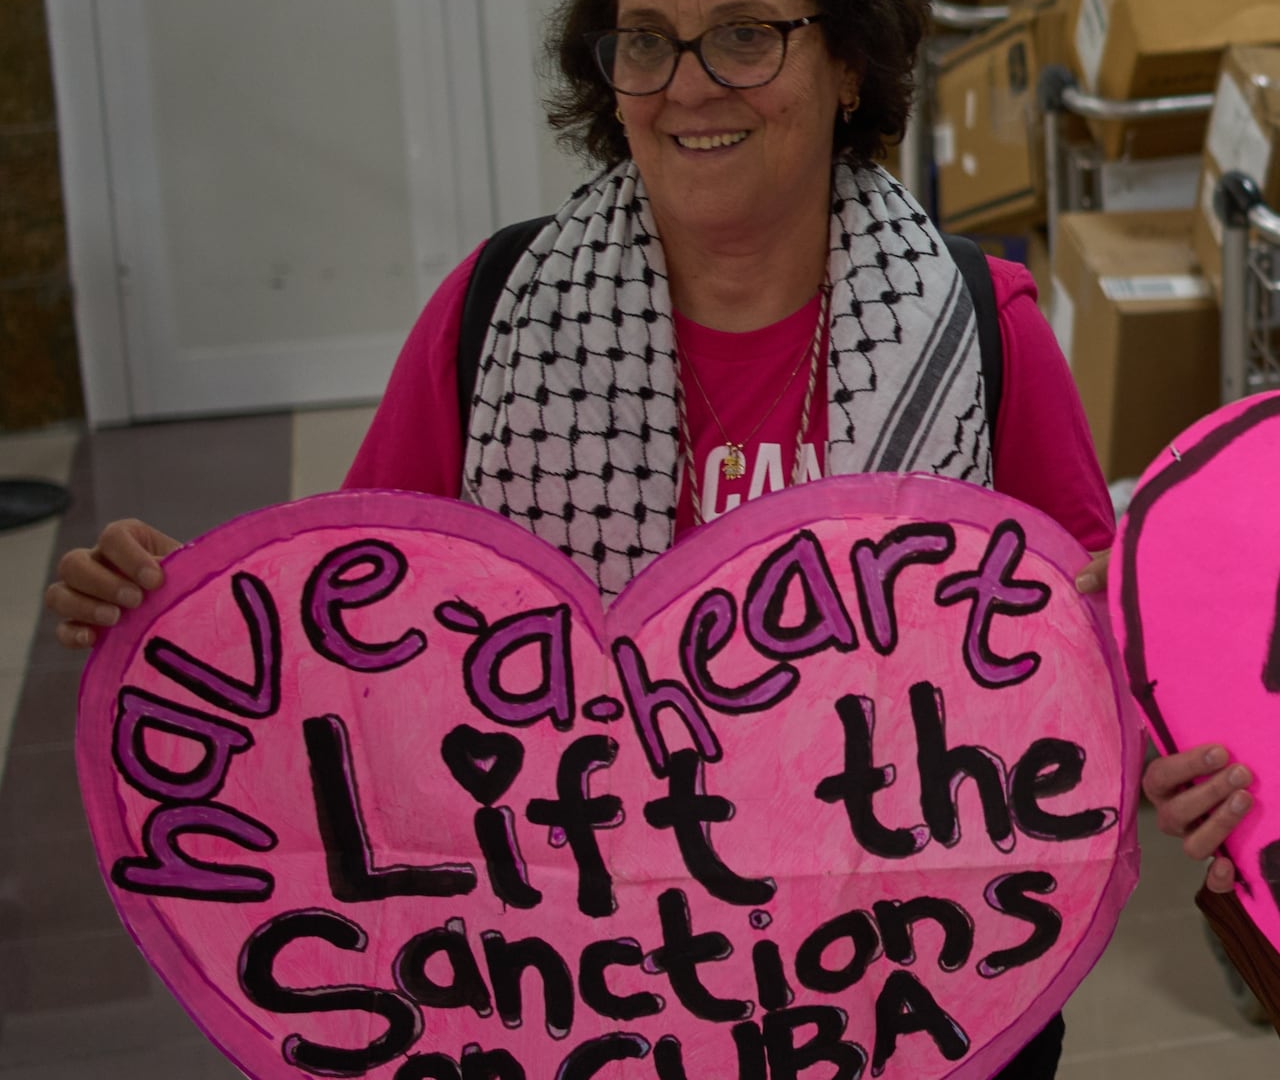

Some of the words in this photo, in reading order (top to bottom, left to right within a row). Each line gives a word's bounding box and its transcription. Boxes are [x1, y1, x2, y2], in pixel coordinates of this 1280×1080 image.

[111, 537, 427, 903] have
[463, 603, 572, 730] a
[611, 519, 1052, 780] heart
[302, 713, 777, 918] Lift
[815, 681, 1119, 860] the
[237, 871, 1063, 1078] Sanctions
